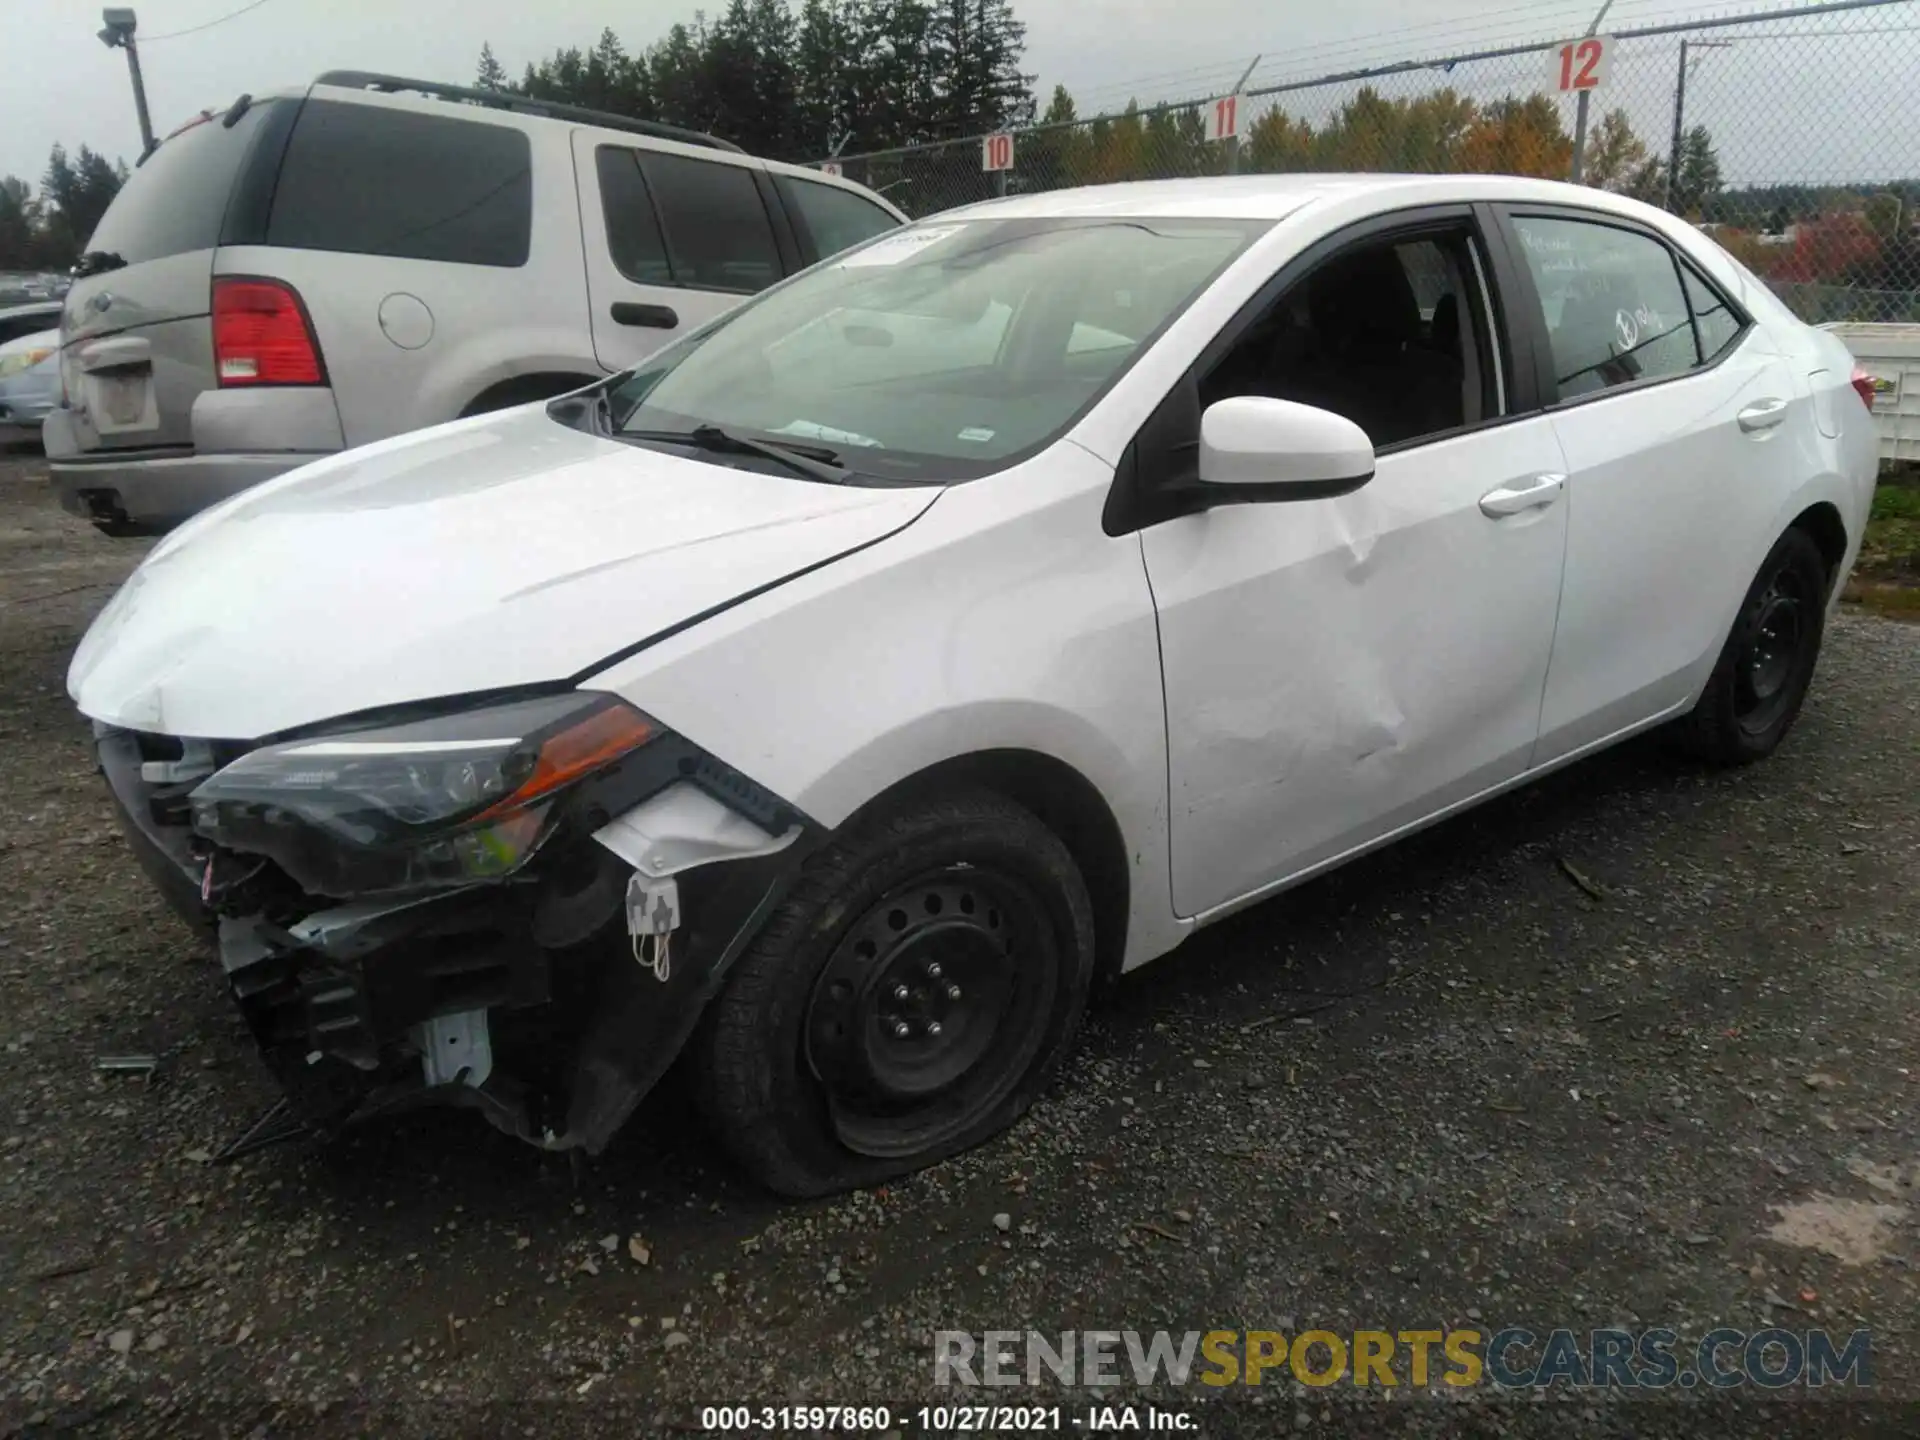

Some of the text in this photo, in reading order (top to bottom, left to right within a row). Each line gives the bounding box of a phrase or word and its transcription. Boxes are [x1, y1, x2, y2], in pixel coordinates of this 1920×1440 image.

[1559, 40, 1602, 90] 12
[1216, 97, 1236, 137] 11
[988, 135, 1009, 169] 10
